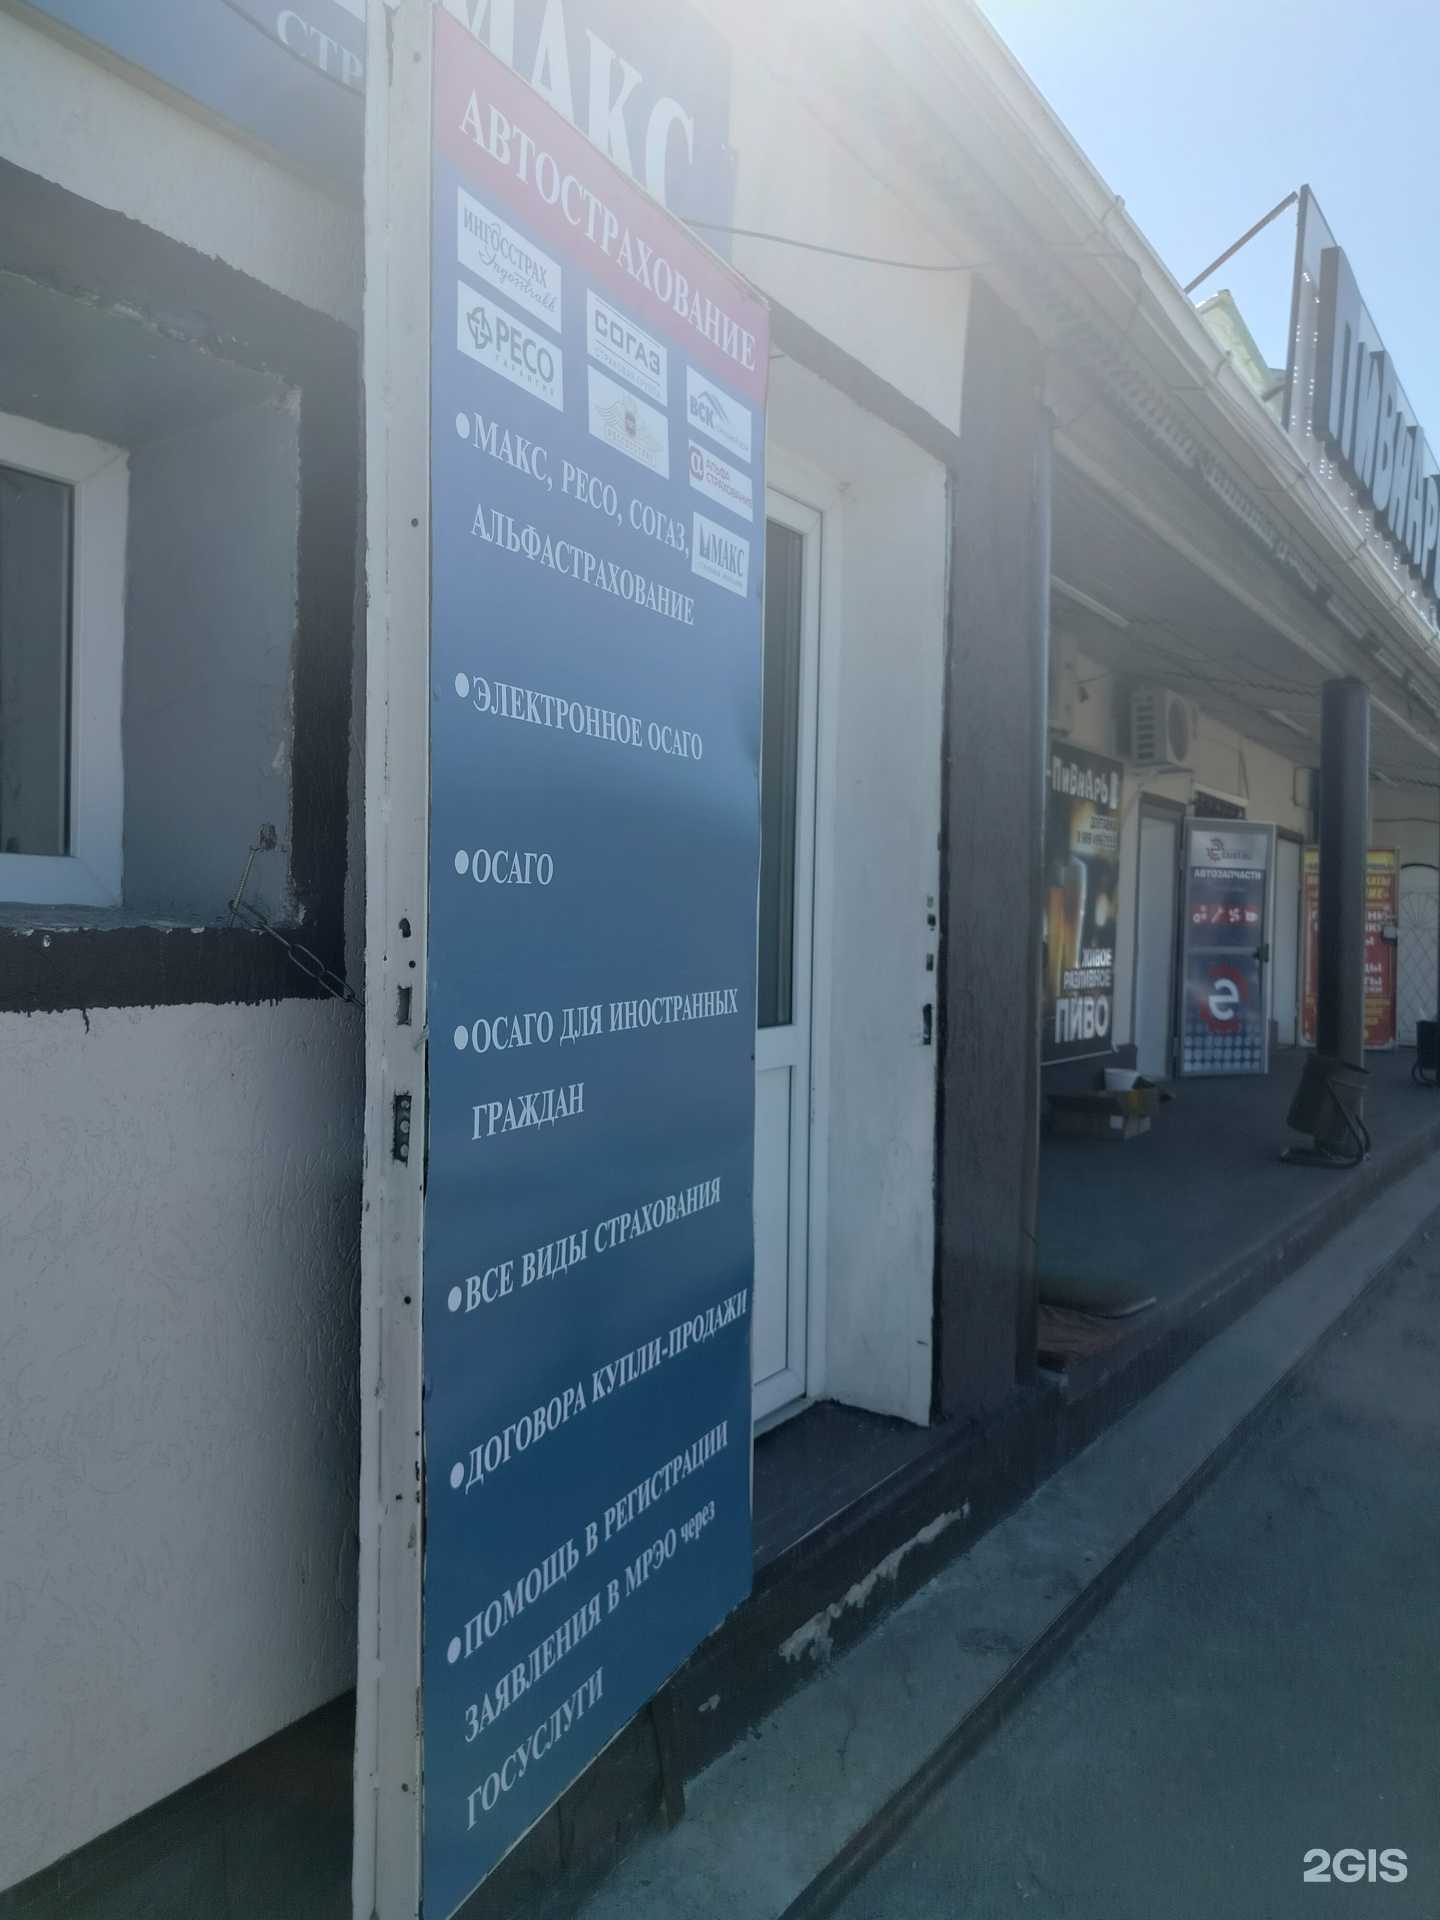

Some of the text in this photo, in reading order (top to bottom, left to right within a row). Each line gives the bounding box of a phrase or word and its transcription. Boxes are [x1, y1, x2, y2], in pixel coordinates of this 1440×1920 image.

[459, 88, 756, 371] АВТОСТРАХОВАНИЕ
[463, 210, 548, 289] ИНГОССТРАХ
[496, 317, 554, 383] РЕСО
[594, 310, 660, 377] СОГАЗ
[689, 394, 716, 430] ВСК
[1315, 246, 1440, 600] ПИВНАР
[473, 412, 553, 491] МАКС,
[561, 459, 623, 527] РЕСО,
[630, 498, 690, 559] СОГАЗ,
[471, 503, 695, 625] АЛЬФАСТРАХОВАНИЕ
[711, 533, 745, 577] МАКС
[472, 675, 703, 760] ЭЛЕКТРОННОЕ ОСАГО
[472, 849, 553, 885] ОСАГО
[1193, 868, 1262, 881] АВТОЗАПЧАСТИ
[472, 988, 739, 1053] ОСАГО ДЛЯ ИНОСТРАННЫХ
[1054, 995, 1109, 1044] ПИВО
[472, 1082, 585, 1140] ГРАЖДАН
[465, 1177, 721, 1313] ВСЕ ВИДЫ СТРАХОВАНИЯ
[465, 1288, 747, 1495] ДОГОВОРА КУПЛИ-ПРОДАЖИ
[463, 1420, 728, 1659] ПОМОЩЬ В РЕГИСТРАЦИИ
[464, 1500, 716, 1743] ЗАЯВЛЕНИЯ В МРЭО через
[467, 1667, 604, 1832] ГОСУСЛУГИ
